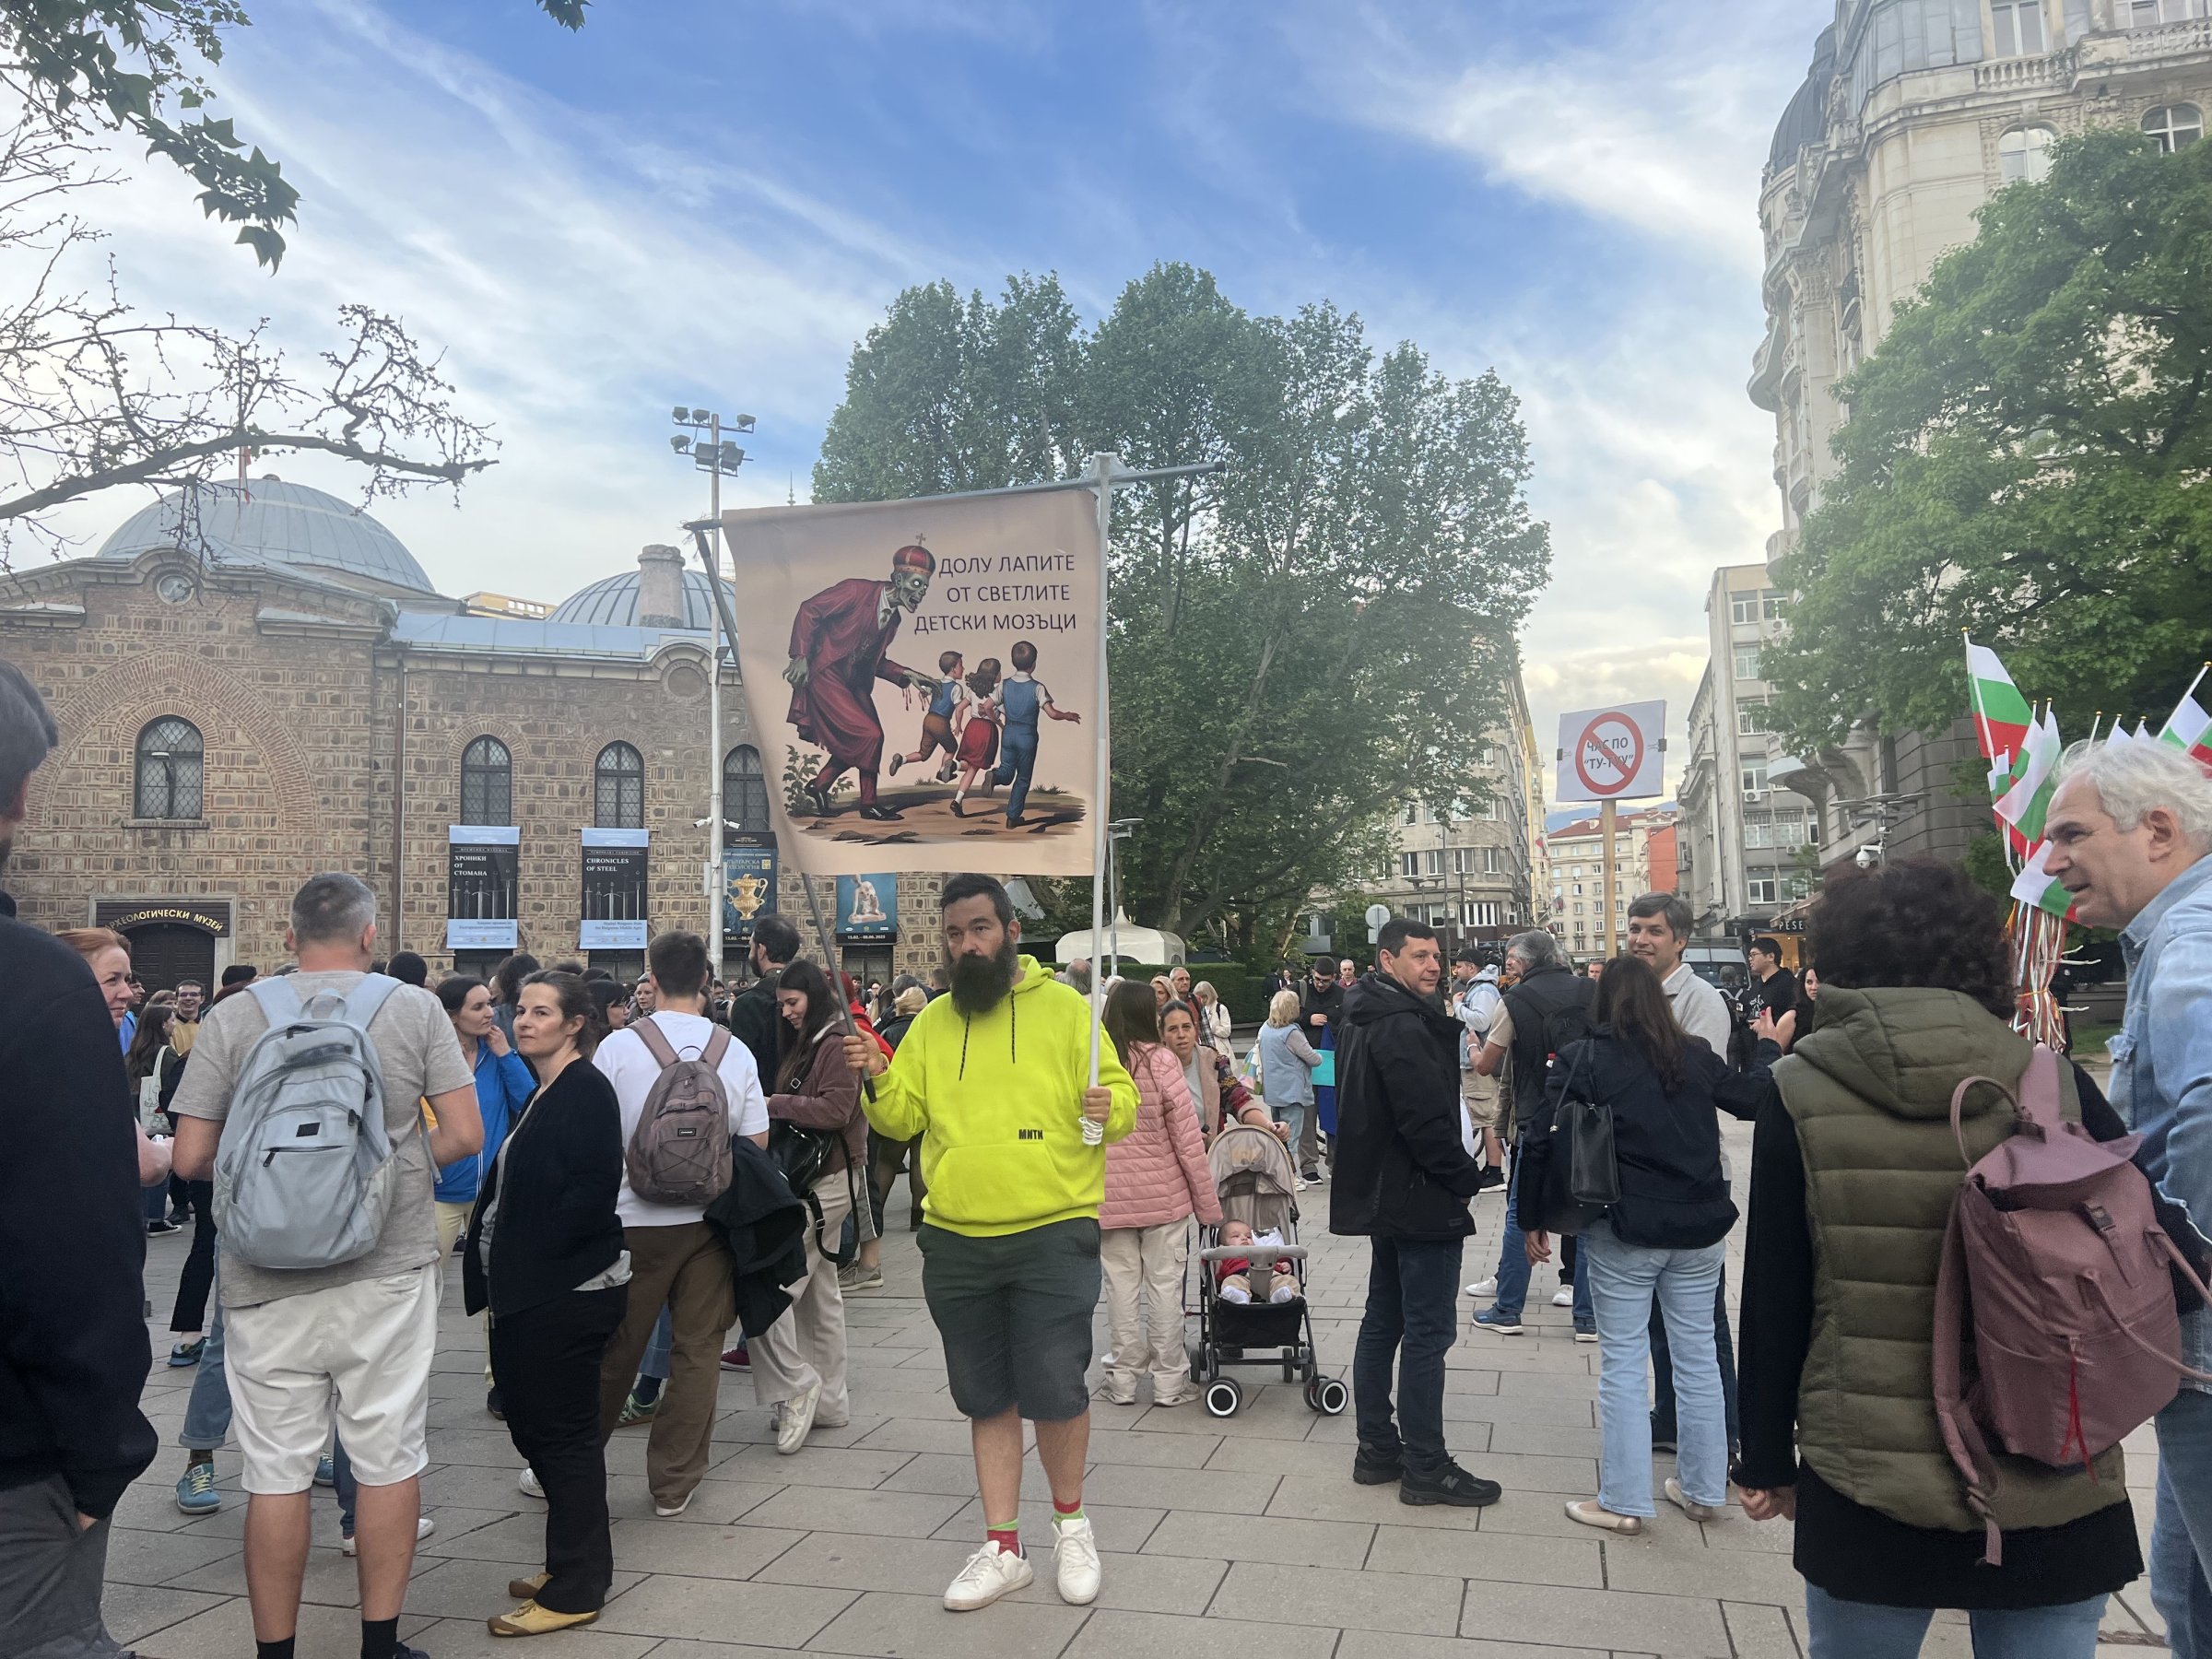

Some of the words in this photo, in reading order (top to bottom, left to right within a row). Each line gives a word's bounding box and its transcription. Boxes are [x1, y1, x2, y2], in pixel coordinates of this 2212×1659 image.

[939, 558, 992, 578] ДОЛУ
[999, 555, 1075, 572] ЛАПИТЕ
[947, 587, 971, 603] ОТ
[977, 584, 1070, 602] СВЕТЛИТЕ
[914, 615, 986, 635] ДЕТСКИ
[994, 614, 1077, 633] МОЗЪЦИ
[1587, 739, 1609, 751] ЧАС
[1612, 737, 1629, 749] ПО
[194, 913, 223, 932] МУЗЕЙ
